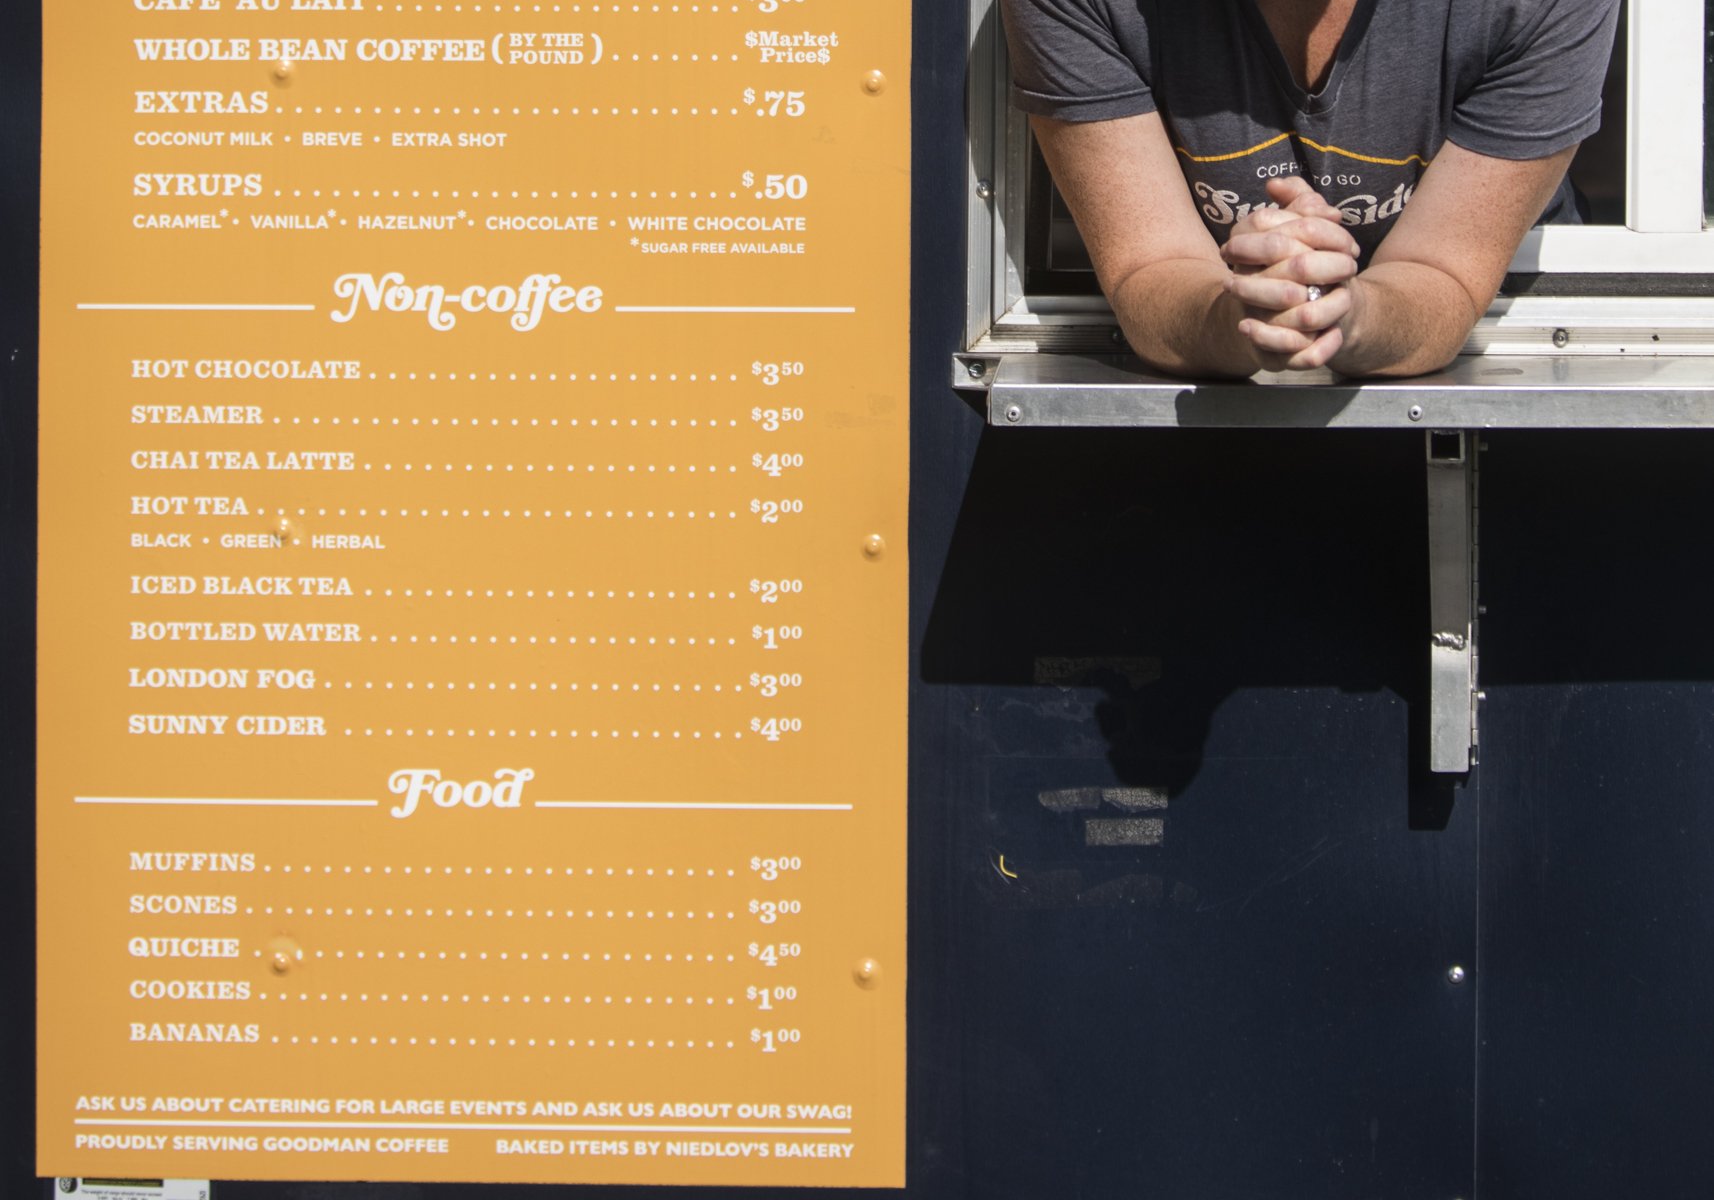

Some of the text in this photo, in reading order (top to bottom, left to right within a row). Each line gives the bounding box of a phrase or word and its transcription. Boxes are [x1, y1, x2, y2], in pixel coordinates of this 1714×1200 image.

[133, 37, 486, 62] WHOLE BEAN COFFEE
[541, 32, 584, 48] THE
[744, 30, 839, 48] $Market
[759, 47, 832, 66] Price$
[134, 90, 269, 114] EXTRAS
[133, 130, 508, 148] COCONUT MILK BREVE EXTRA SHOT
[132, 172, 263, 197] SYRUPS
[1336, 174, 1362, 186] GO
[485, 215, 599, 231] CHOCOLATE
[627, 215, 688, 231] WHITE
[693, 215, 807, 232] CHOCOLATE
[691, 242, 727, 254] FREE
[729, 242, 805, 255] AVAILABLE
[329, 271, 604, 333] Non-coffee
[131, 359, 189, 379] HOT
[194, 359, 361, 380] CHOCOLATE
[130, 404, 264, 425] STEAMER
[130, 450, 199, 470] CHAI
[204, 451, 261, 470] TEA
[265, 451, 355, 471] LATTE
[130, 495, 189, 516] HOT
[193, 496, 250, 516] TEA
[130, 532, 386, 550] BLACK GREEN HERBAL
[130, 575, 197, 595] ICED
[202, 575, 293, 596] BLACK
[297, 576, 354, 597] TEA
[129, 621, 257, 642] BOTTLED
[261, 622, 362, 643] WATER
[128, 667, 249, 689] LONDON
[256, 668, 316, 690] FOG
[127, 713, 229, 735] SUNNY
[235, 715, 327, 737] CIDER
[387, 767, 535, 820] Food
[129, 851, 256, 873] MUFFINS
[129, 894, 238, 915] SCONES
[127, 936, 240, 959] QUICHE
[129, 979, 251, 1001] COOKIES
[129, 1022, 260, 1044] BANANAS
[75, 1095, 853, 1121] ASK US ABOUT CATERING FOR LARGE EVENTS AND ASK US ABOUT OUR SWAG!
[75, 1134, 449, 1154] PROUDLY SERVING GOODMAN COFFEE
[495, 1139, 854, 1159] BAKED ITEMS BY NIEDLOV'S BAKERY
